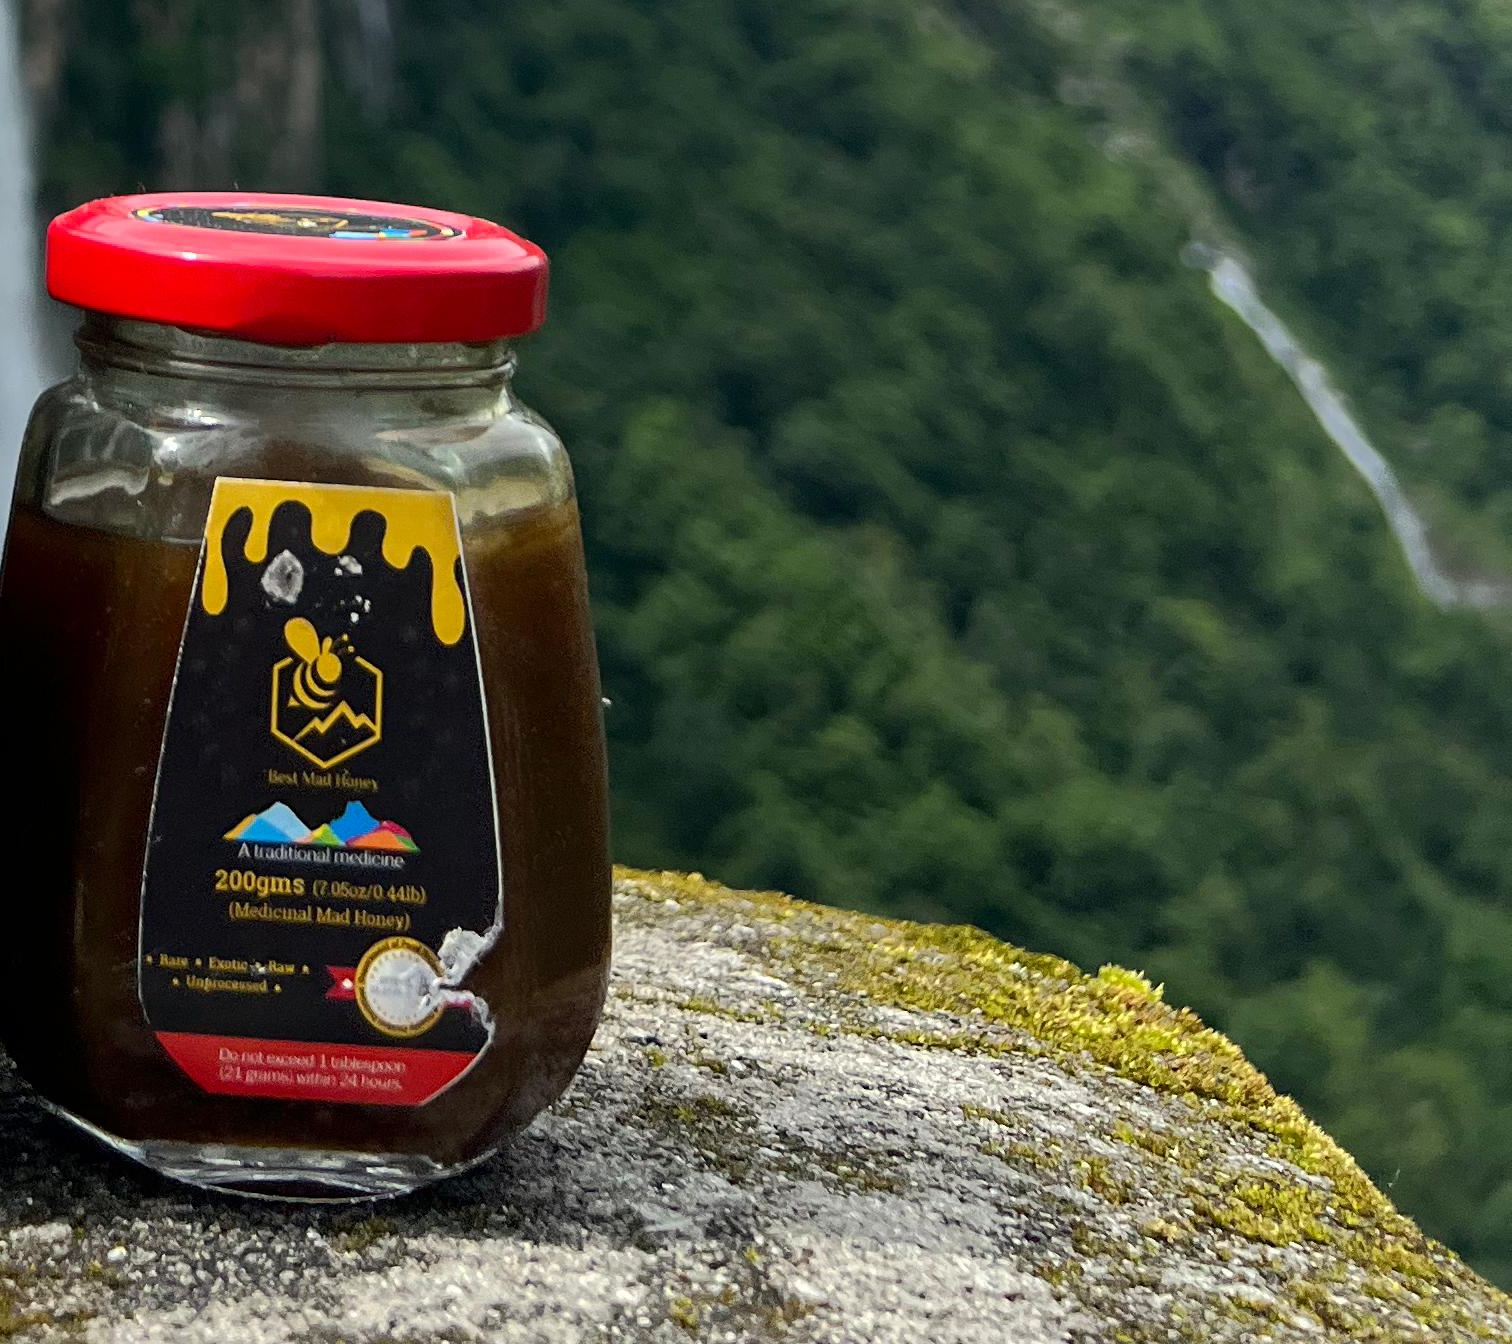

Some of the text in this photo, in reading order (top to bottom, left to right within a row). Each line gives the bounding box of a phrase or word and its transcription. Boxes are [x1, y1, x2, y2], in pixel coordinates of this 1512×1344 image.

[238, 841, 406, 869] A traditional medicine
[215, 869, 306, 898] 200gms
[228, 901, 411, 931] (Medicinal Mad Honey)
